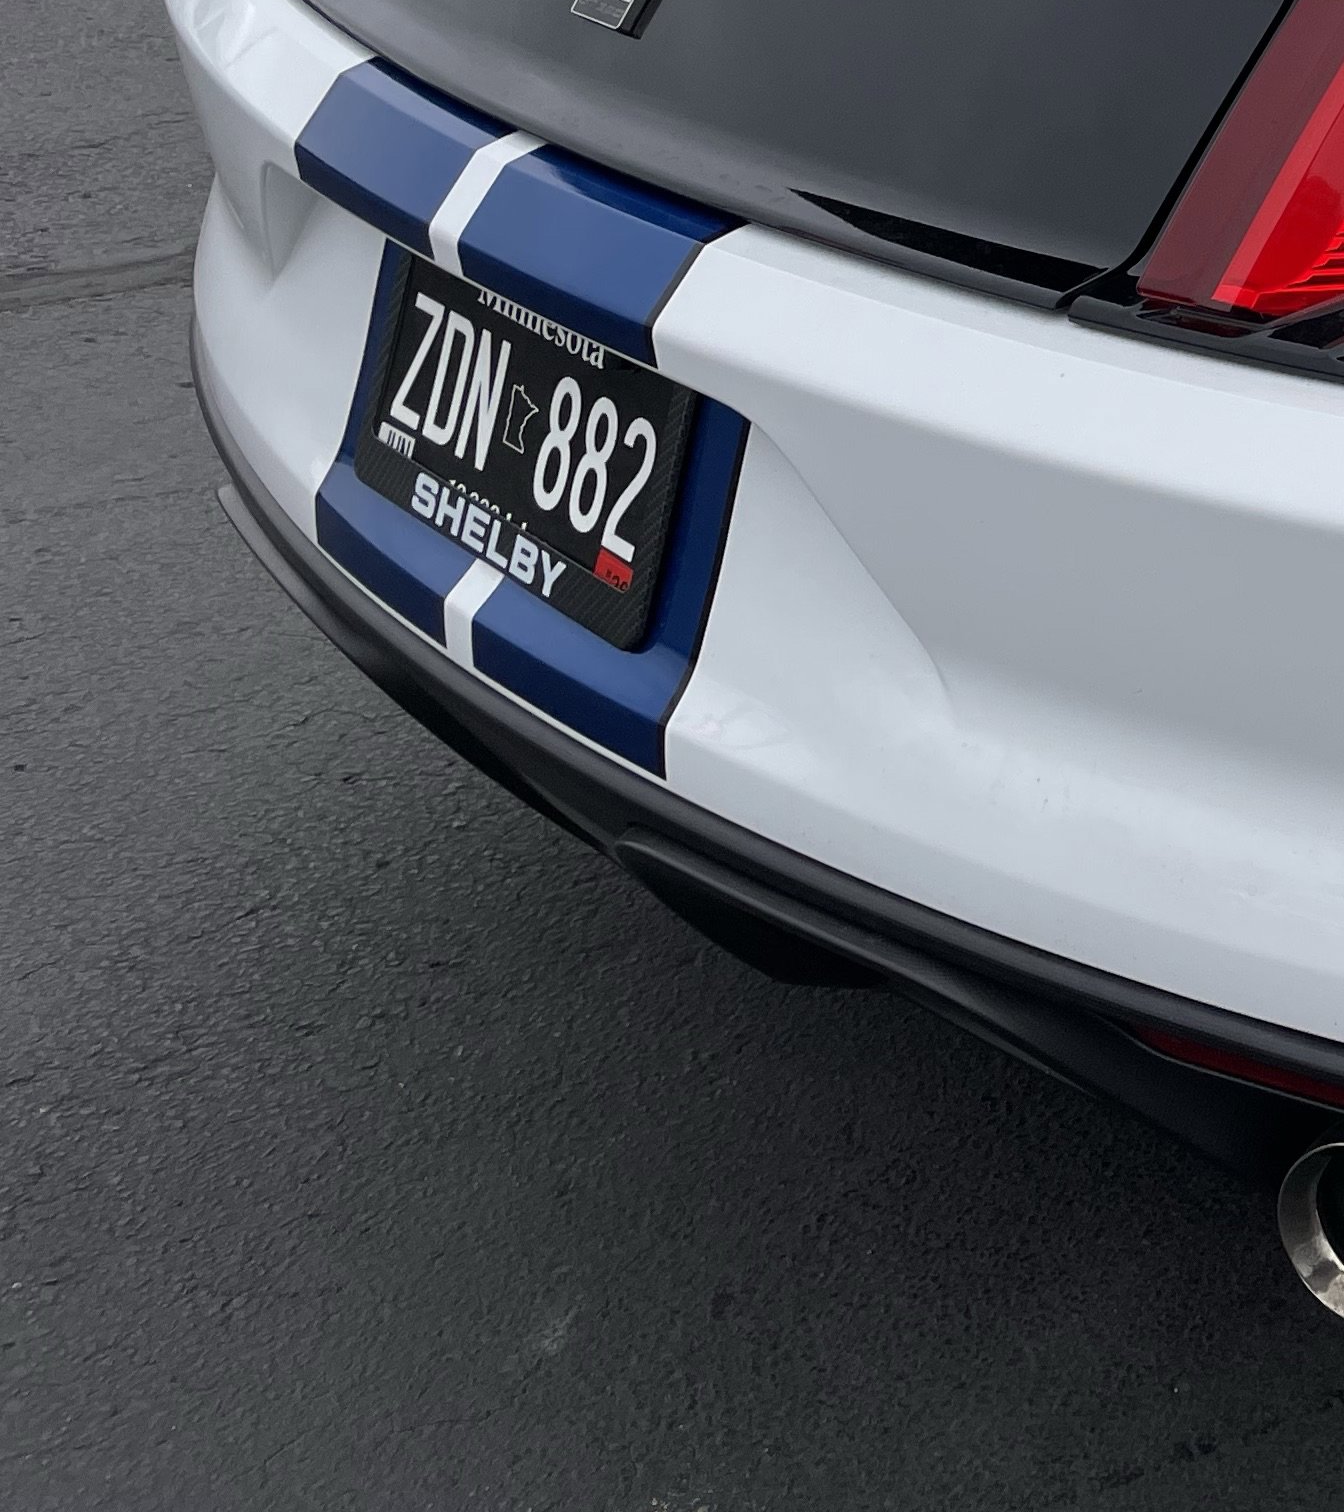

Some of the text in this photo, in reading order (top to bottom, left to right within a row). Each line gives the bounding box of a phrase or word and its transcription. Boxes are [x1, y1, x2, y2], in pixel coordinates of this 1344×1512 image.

[389, 291, 657, 563] ZDN 882
[411, 472, 567, 598] SHELBY
